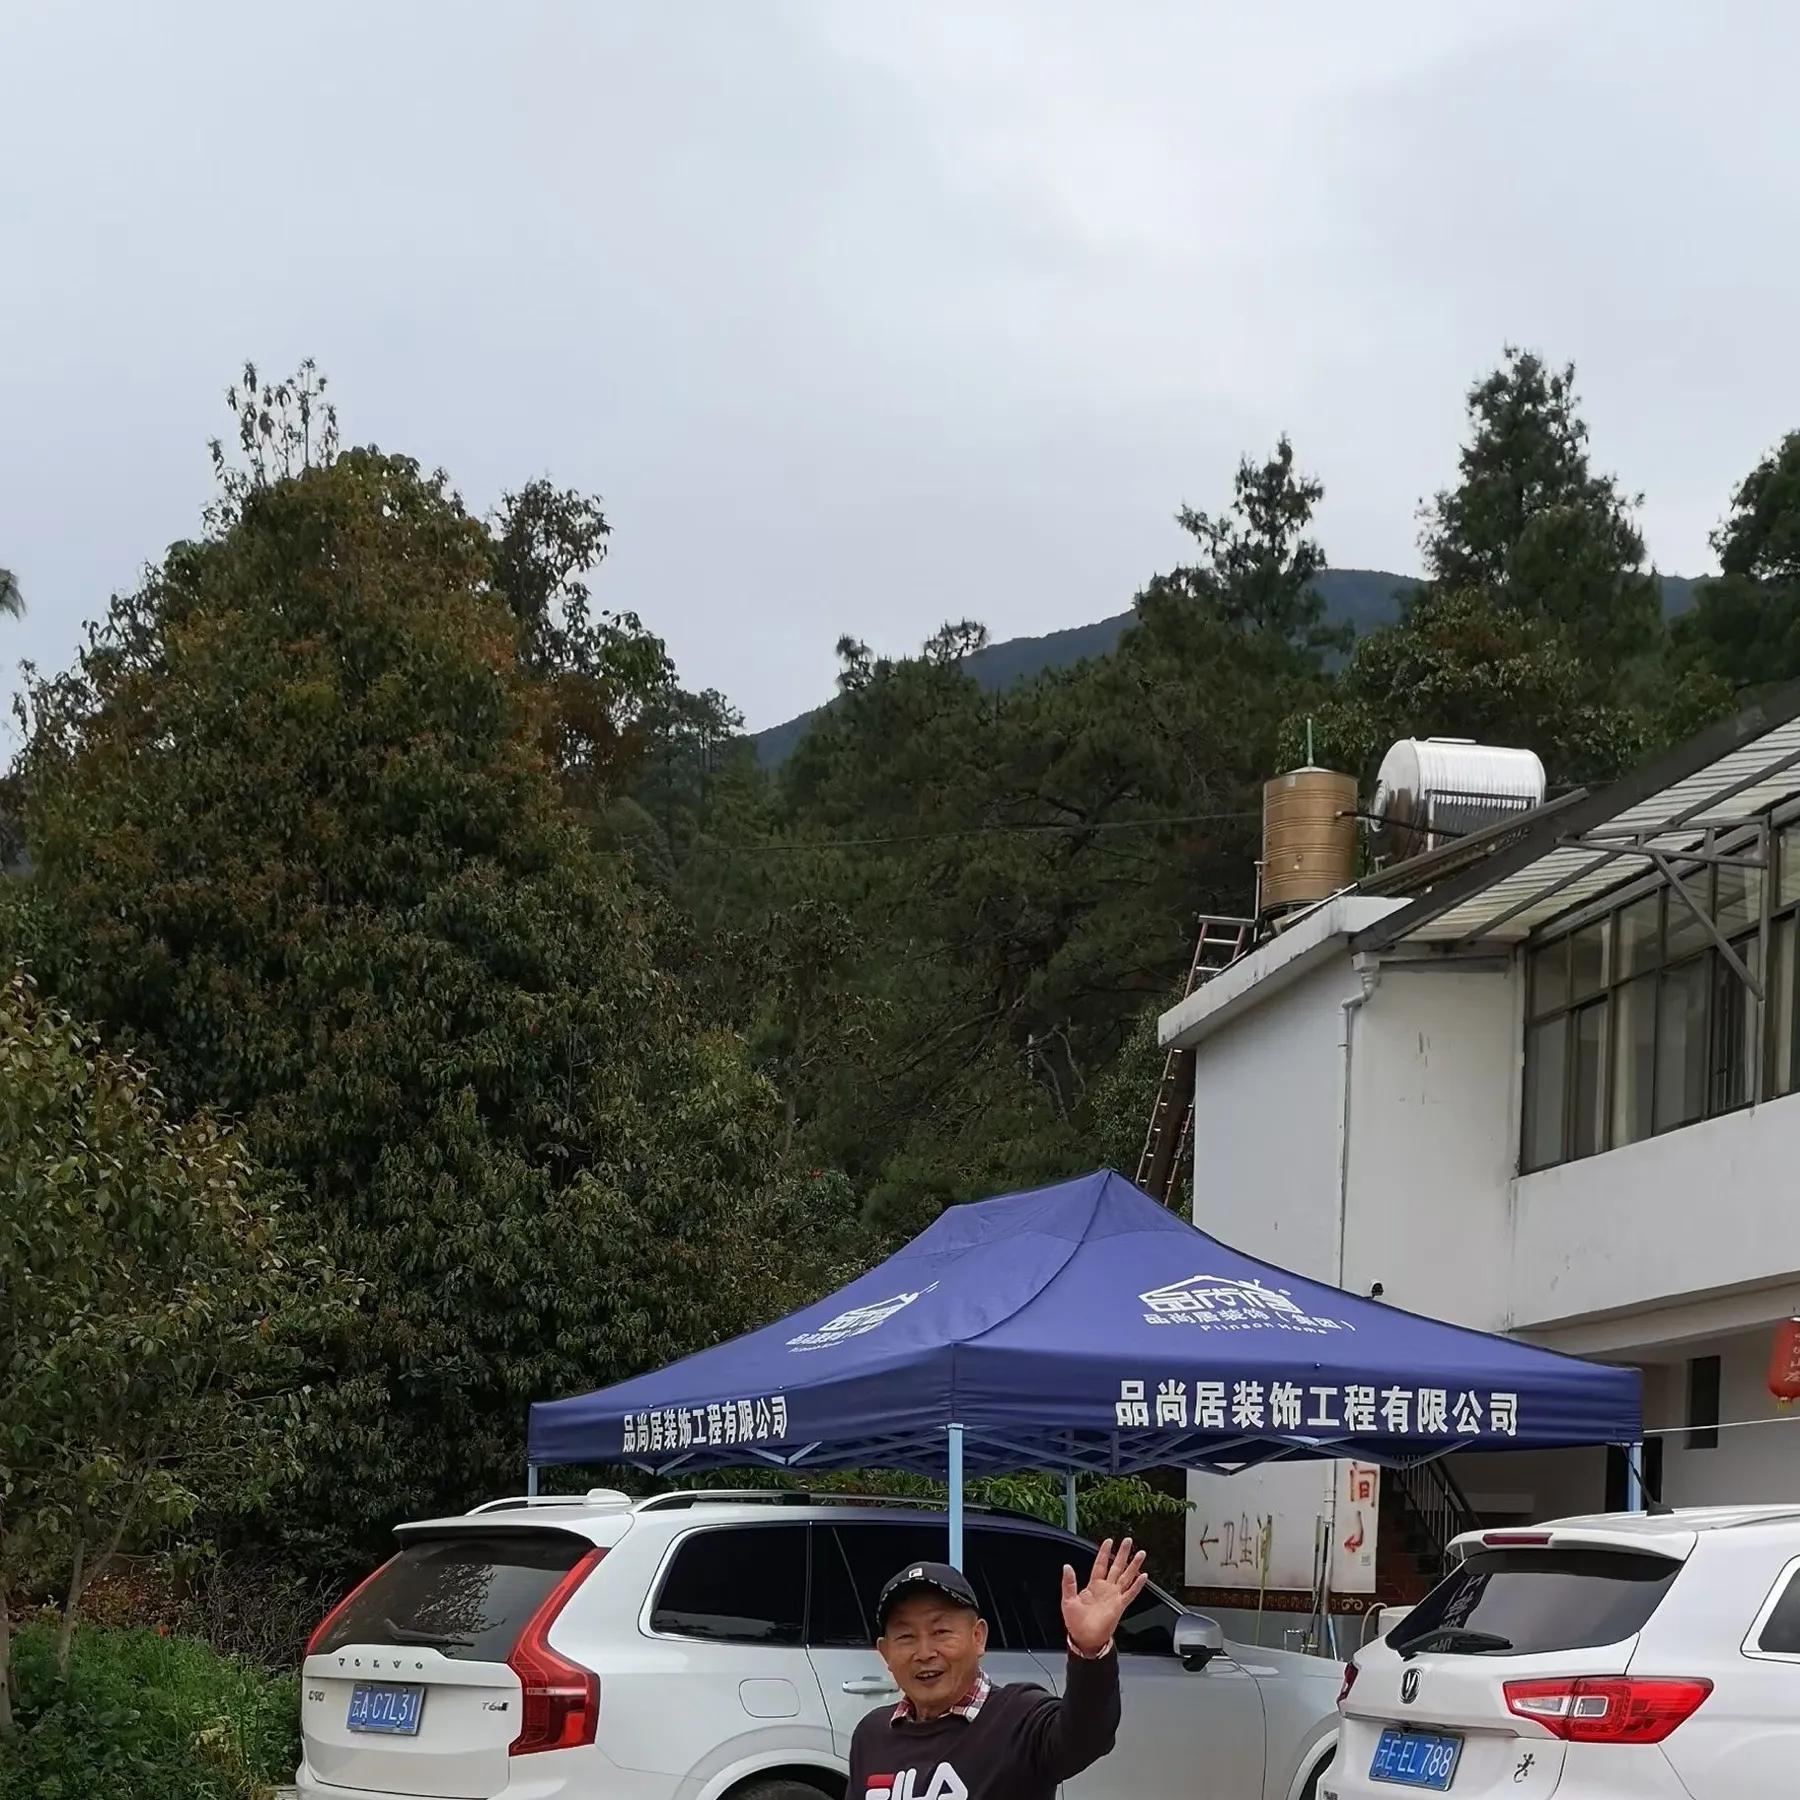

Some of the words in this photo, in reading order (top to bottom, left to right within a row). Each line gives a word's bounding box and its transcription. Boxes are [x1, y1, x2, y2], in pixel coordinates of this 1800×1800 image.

[622, 1396, 788, 1453] 品尚居装饰工程有限公司
[1115, 1379, 1519, 1437] 品尚居装饰工程有限公司
[338, 1657, 423, 1670] VOLVO
